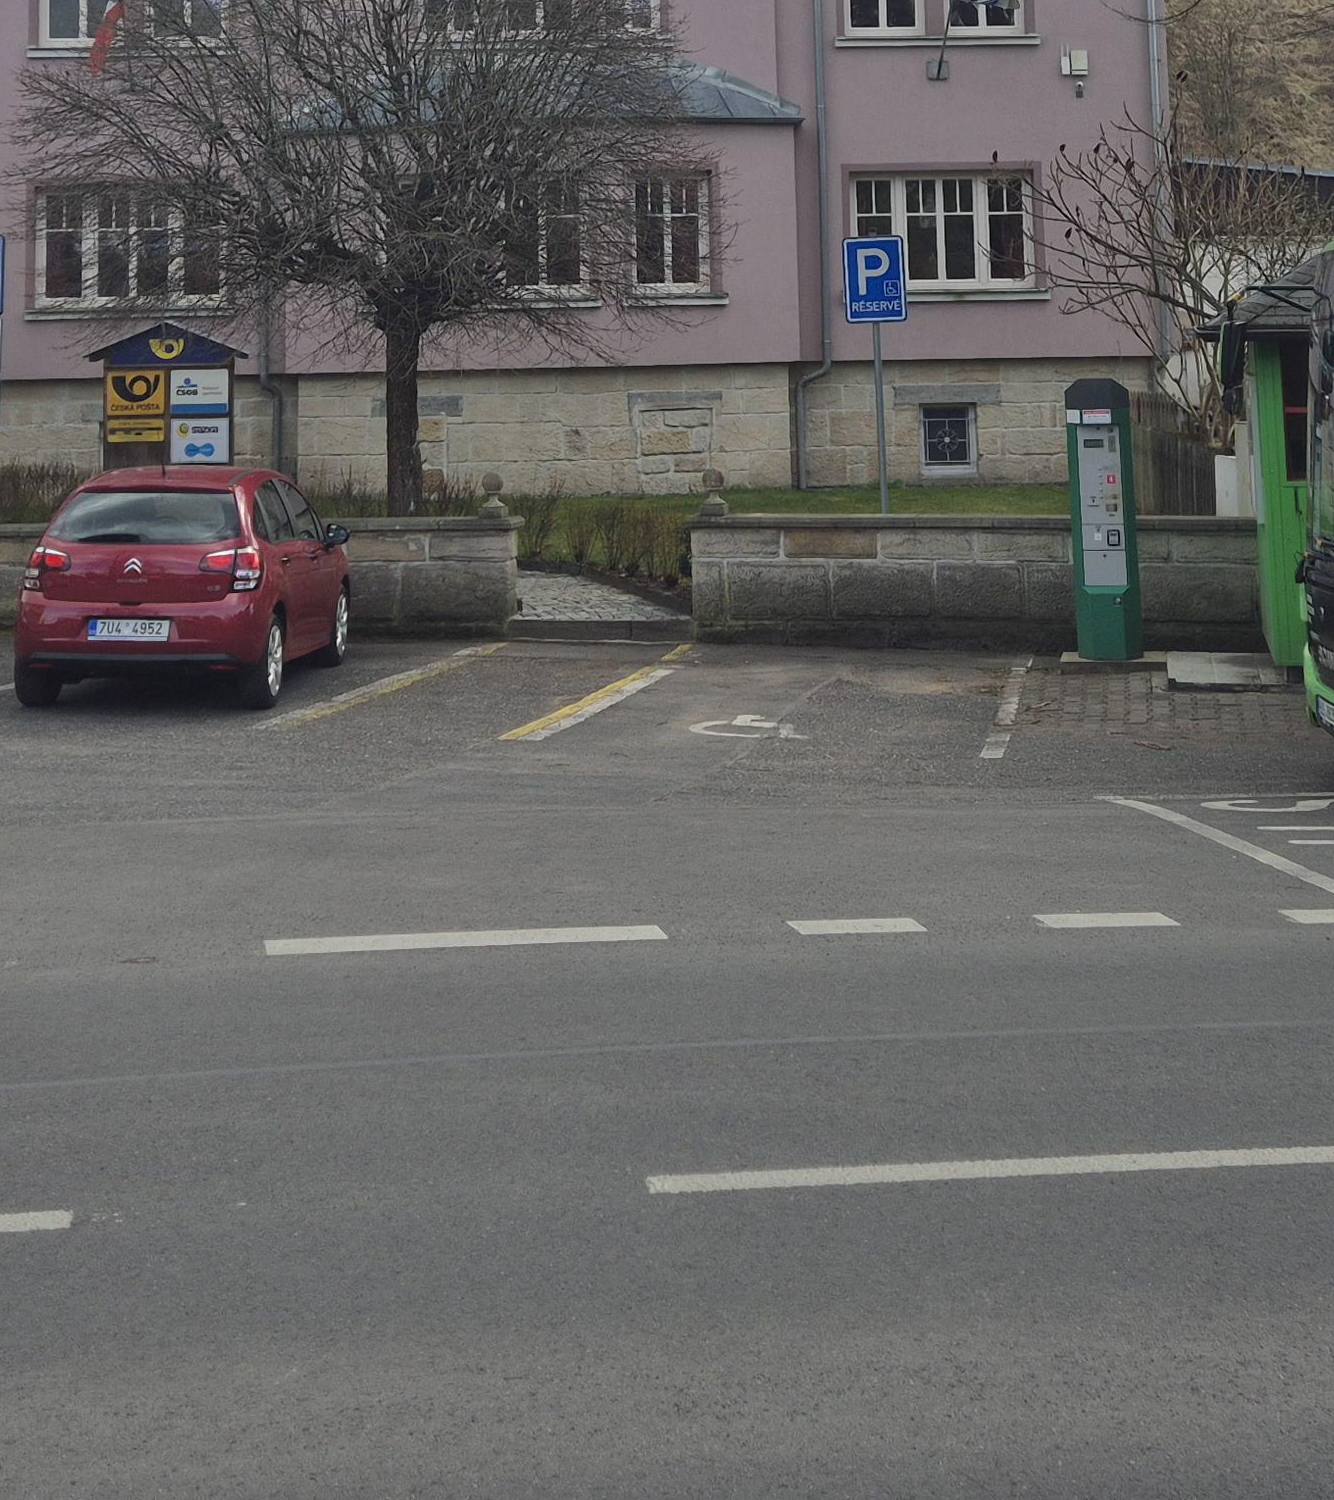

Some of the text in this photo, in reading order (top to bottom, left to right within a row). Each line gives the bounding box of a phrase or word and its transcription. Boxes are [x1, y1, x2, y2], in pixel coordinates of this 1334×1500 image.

[856, 248, 890, 296] P
[851, 299, 901, 312] RÉSERVÉ
[99, 621, 162, 635] 7U4 4952
